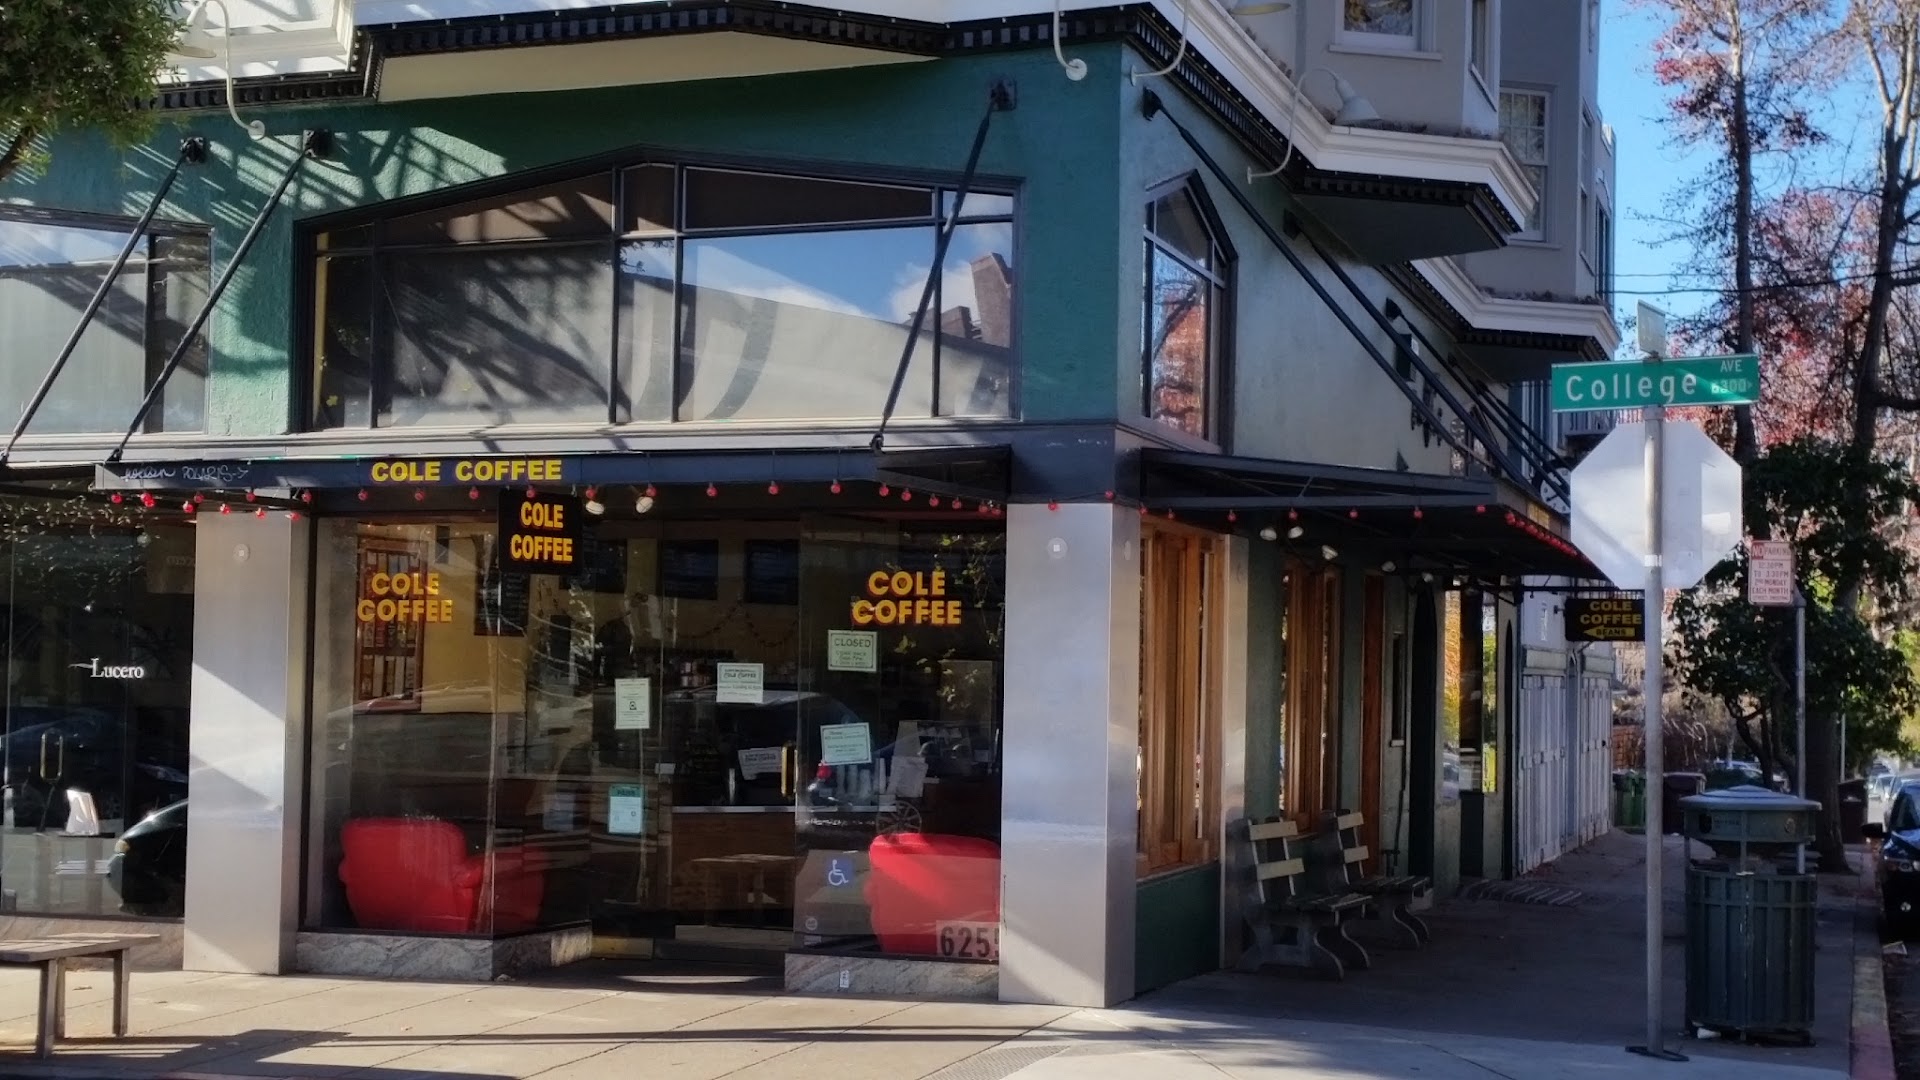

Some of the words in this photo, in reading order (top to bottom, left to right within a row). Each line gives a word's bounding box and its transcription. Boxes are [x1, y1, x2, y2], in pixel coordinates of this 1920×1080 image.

[1565, 373, 1697, 403] College
[1720, 359, 1743, 373] AVE
[371, 461, 441, 482] COLE
[455, 459, 563, 481] COFFEE
[520, 501, 564, 529] COLE
[510, 533, 573, 562] COFFEE
[1752, 544, 1763, 558] NO
[371, 572, 440, 595] COLE
[868, 571, 946, 596] COLE
[357, 598, 454, 622] COFFEE
[852, 599, 962, 624] COFFEE
[1589, 601, 1633, 611] COLE
[1580, 613, 1643, 625] COFFEE
[834, 638, 871, 648] CLOSED
[1595, 628, 1627, 637] BEANS
[89, 657, 145, 679] Lucero
